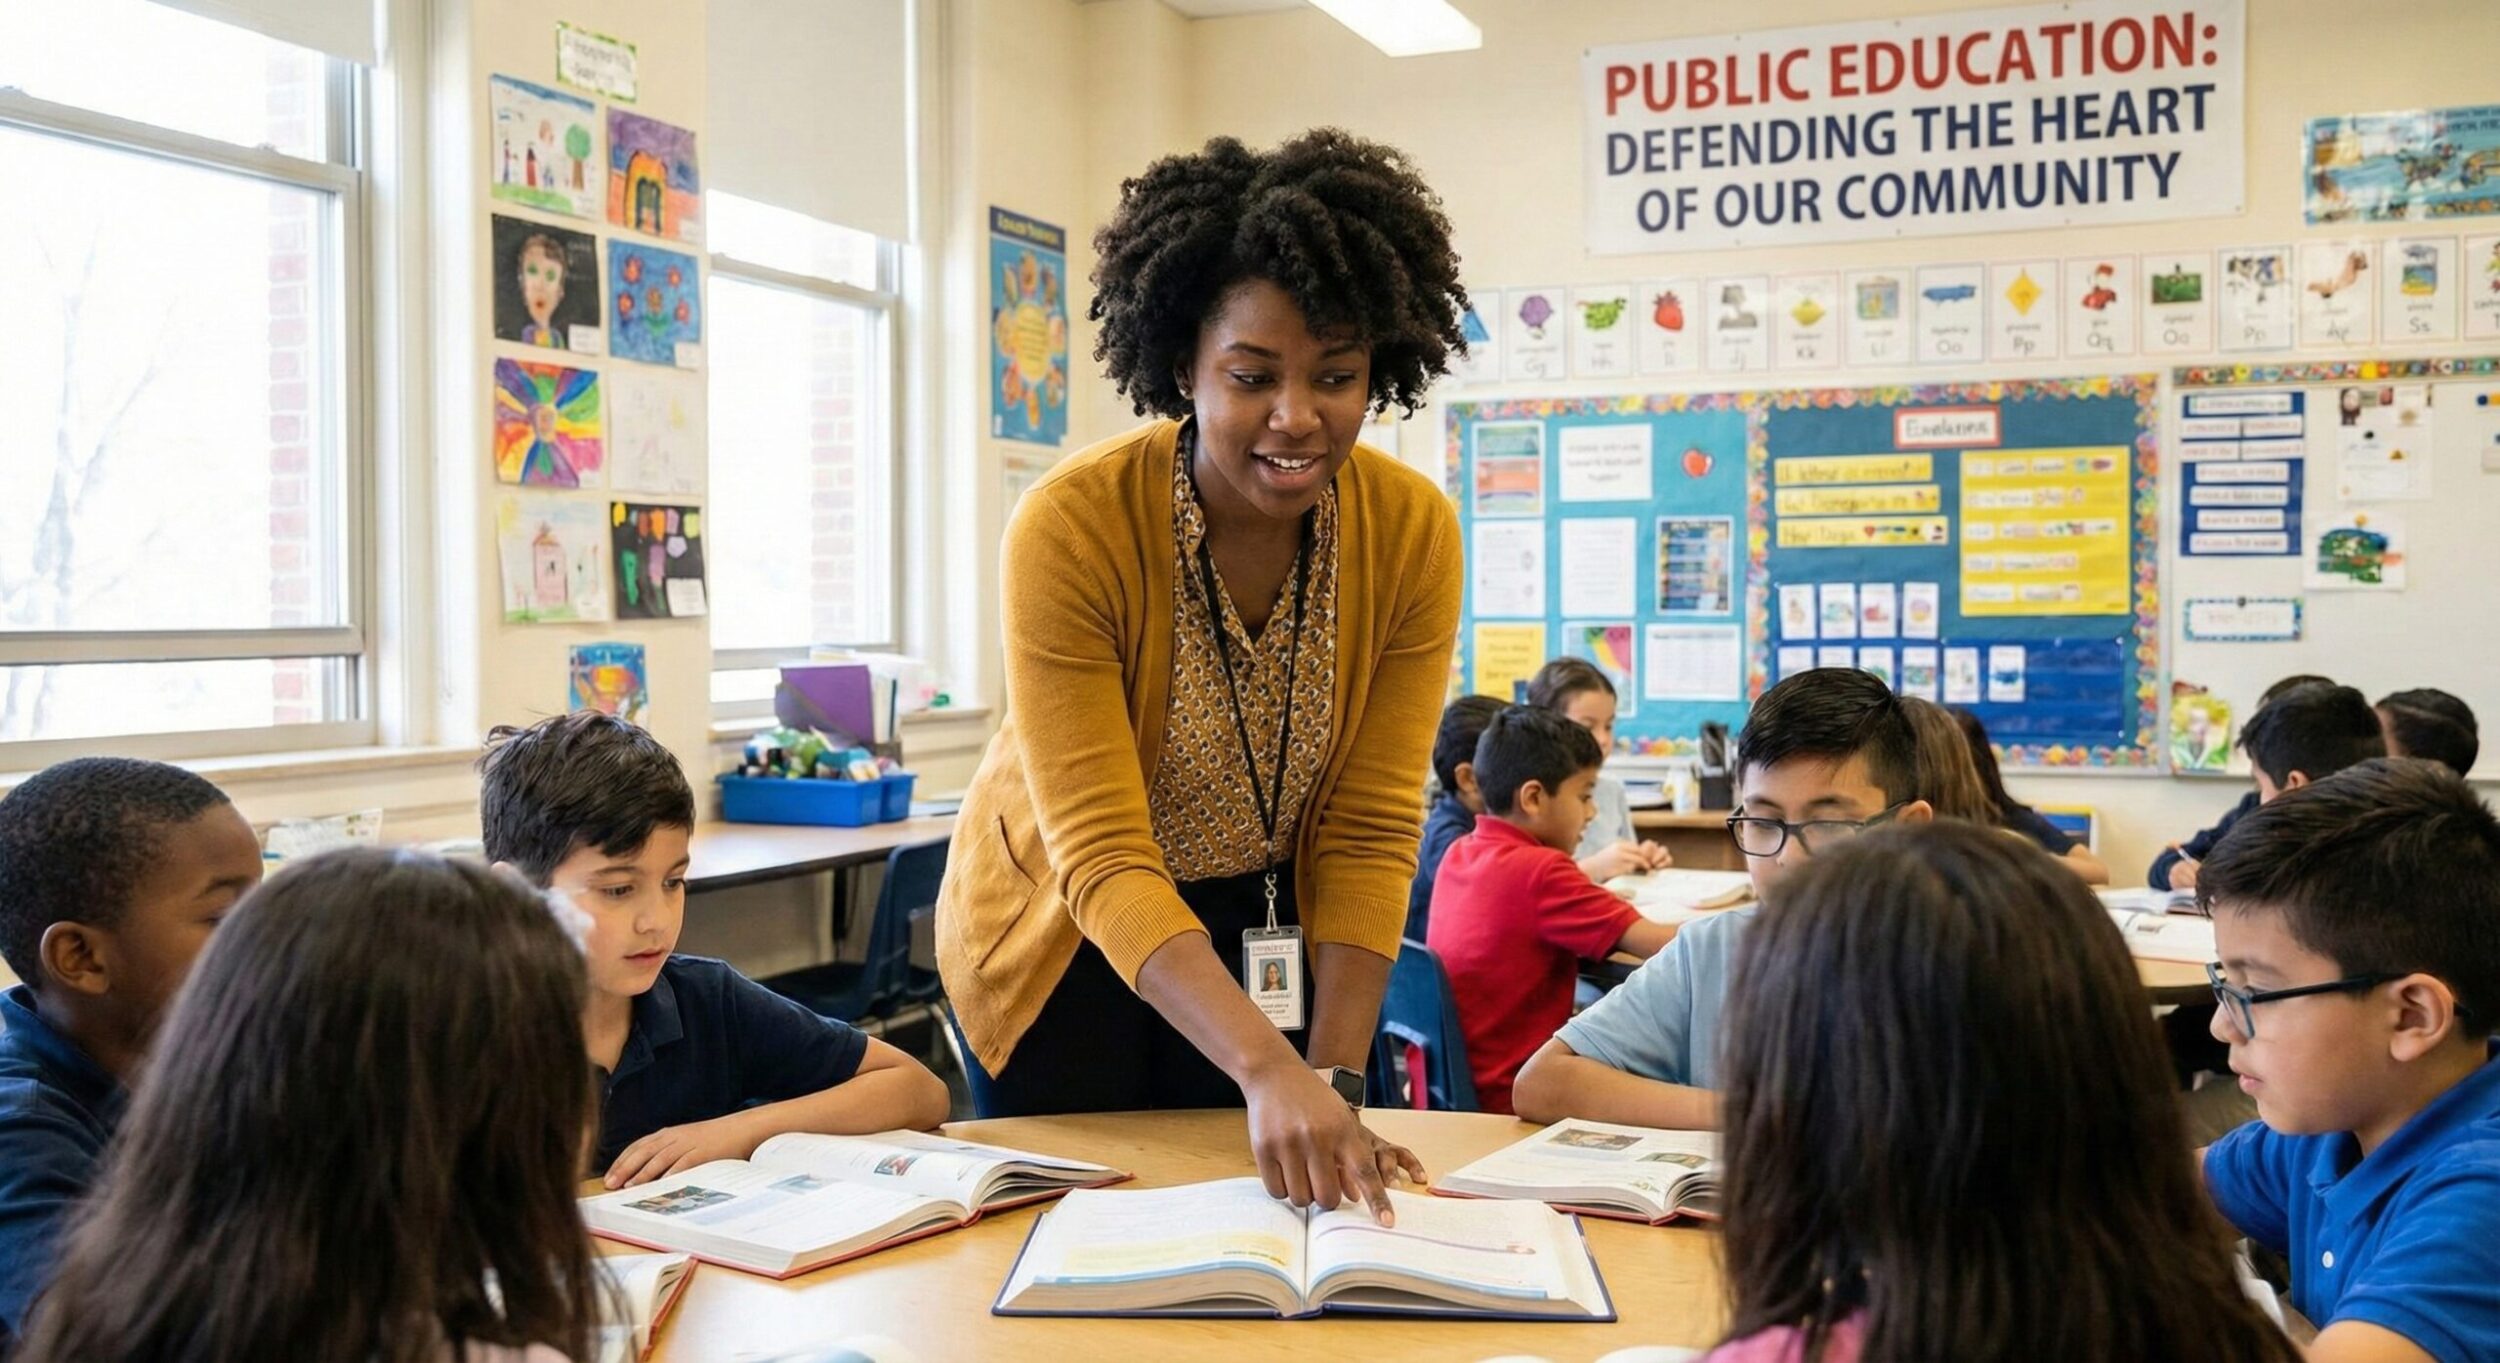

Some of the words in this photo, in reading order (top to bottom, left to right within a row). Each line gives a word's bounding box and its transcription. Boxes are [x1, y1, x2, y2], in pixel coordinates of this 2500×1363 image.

[1606, 49, 1809, 115] PUBLIC
[1829, 12, 2217, 98] EDUCATION:
[1607, 110, 1896, 176] DEFENDING
[1911, 101, 2014, 152] THE
[2032, 84, 2215, 144] HEART
[1637, 187, 1698, 232] OF
[1715, 180, 1822, 227] OUR
[1837, 153, 2181, 220] COMMUNITY
